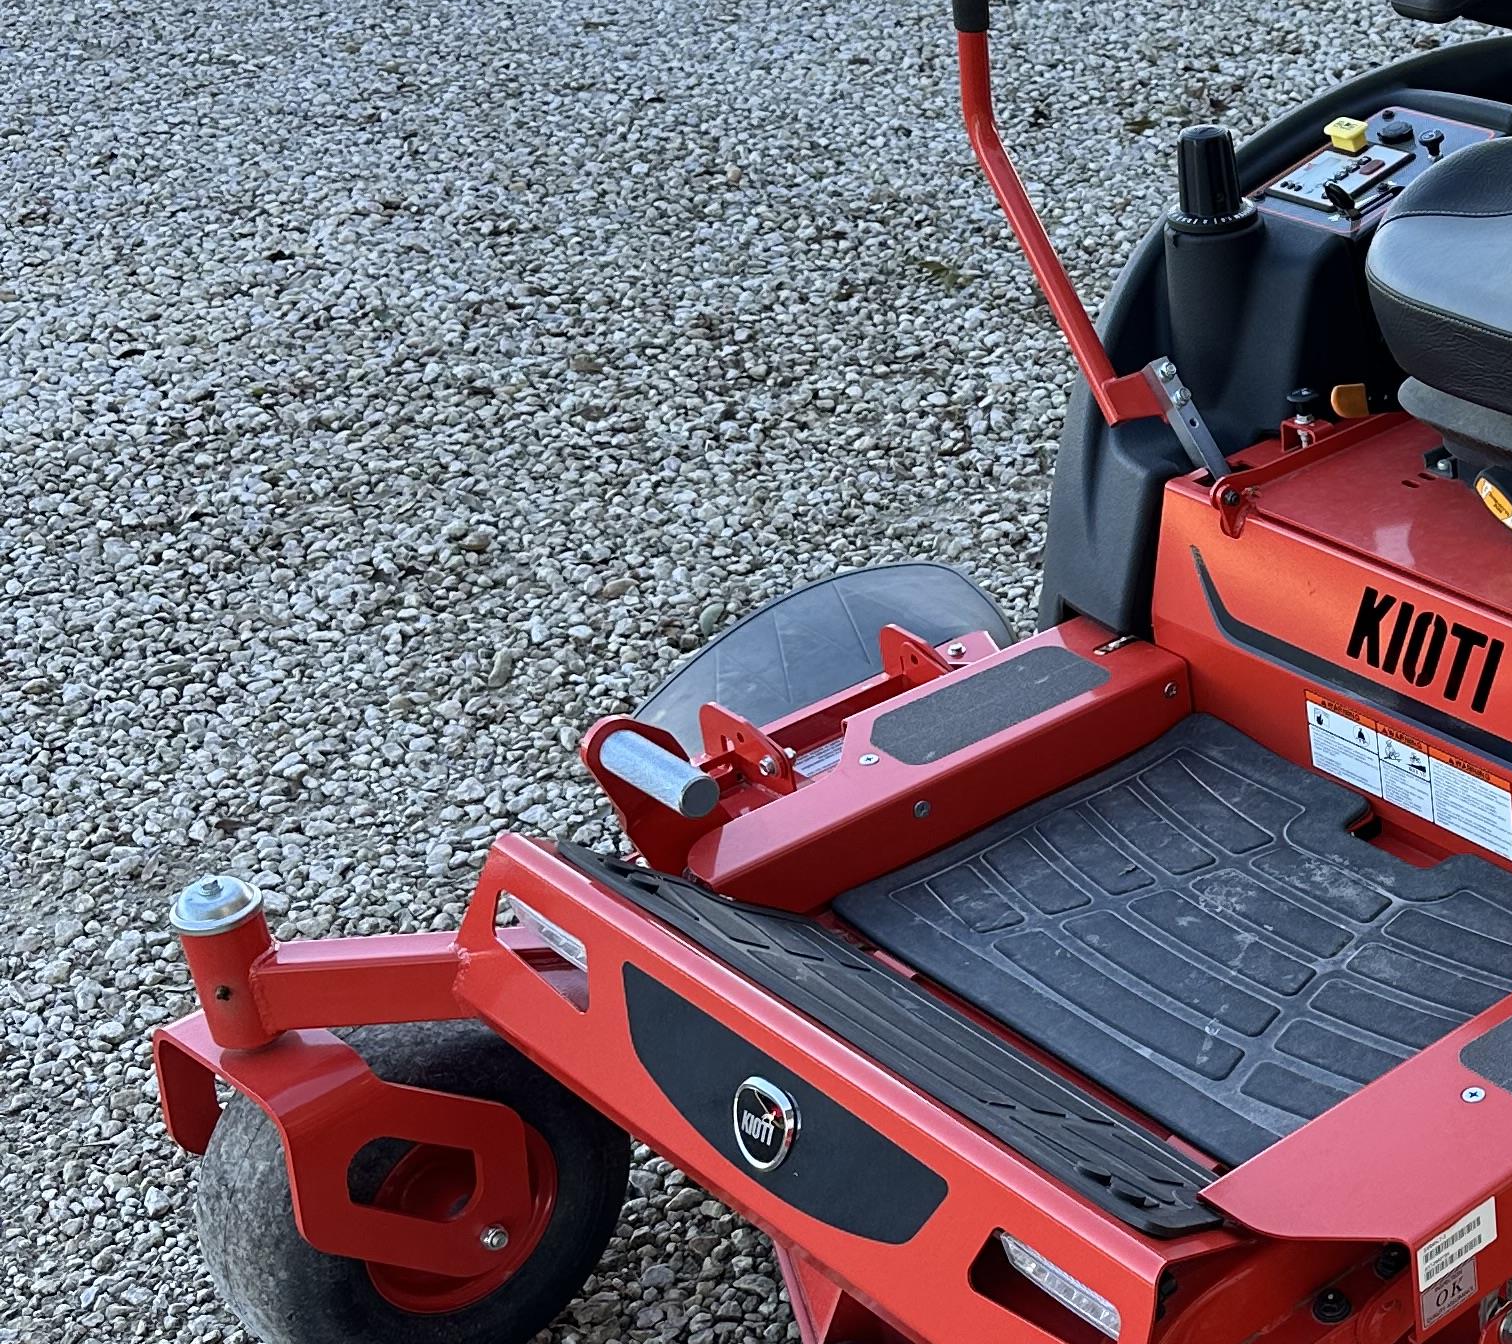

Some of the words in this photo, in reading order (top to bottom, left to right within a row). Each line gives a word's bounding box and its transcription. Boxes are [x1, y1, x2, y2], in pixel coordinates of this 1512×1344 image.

[1346, 586, 1504, 714] KIOTI
[741, 1109, 775, 1147] KIOTI
[1435, 1277, 1464, 1308] OK
